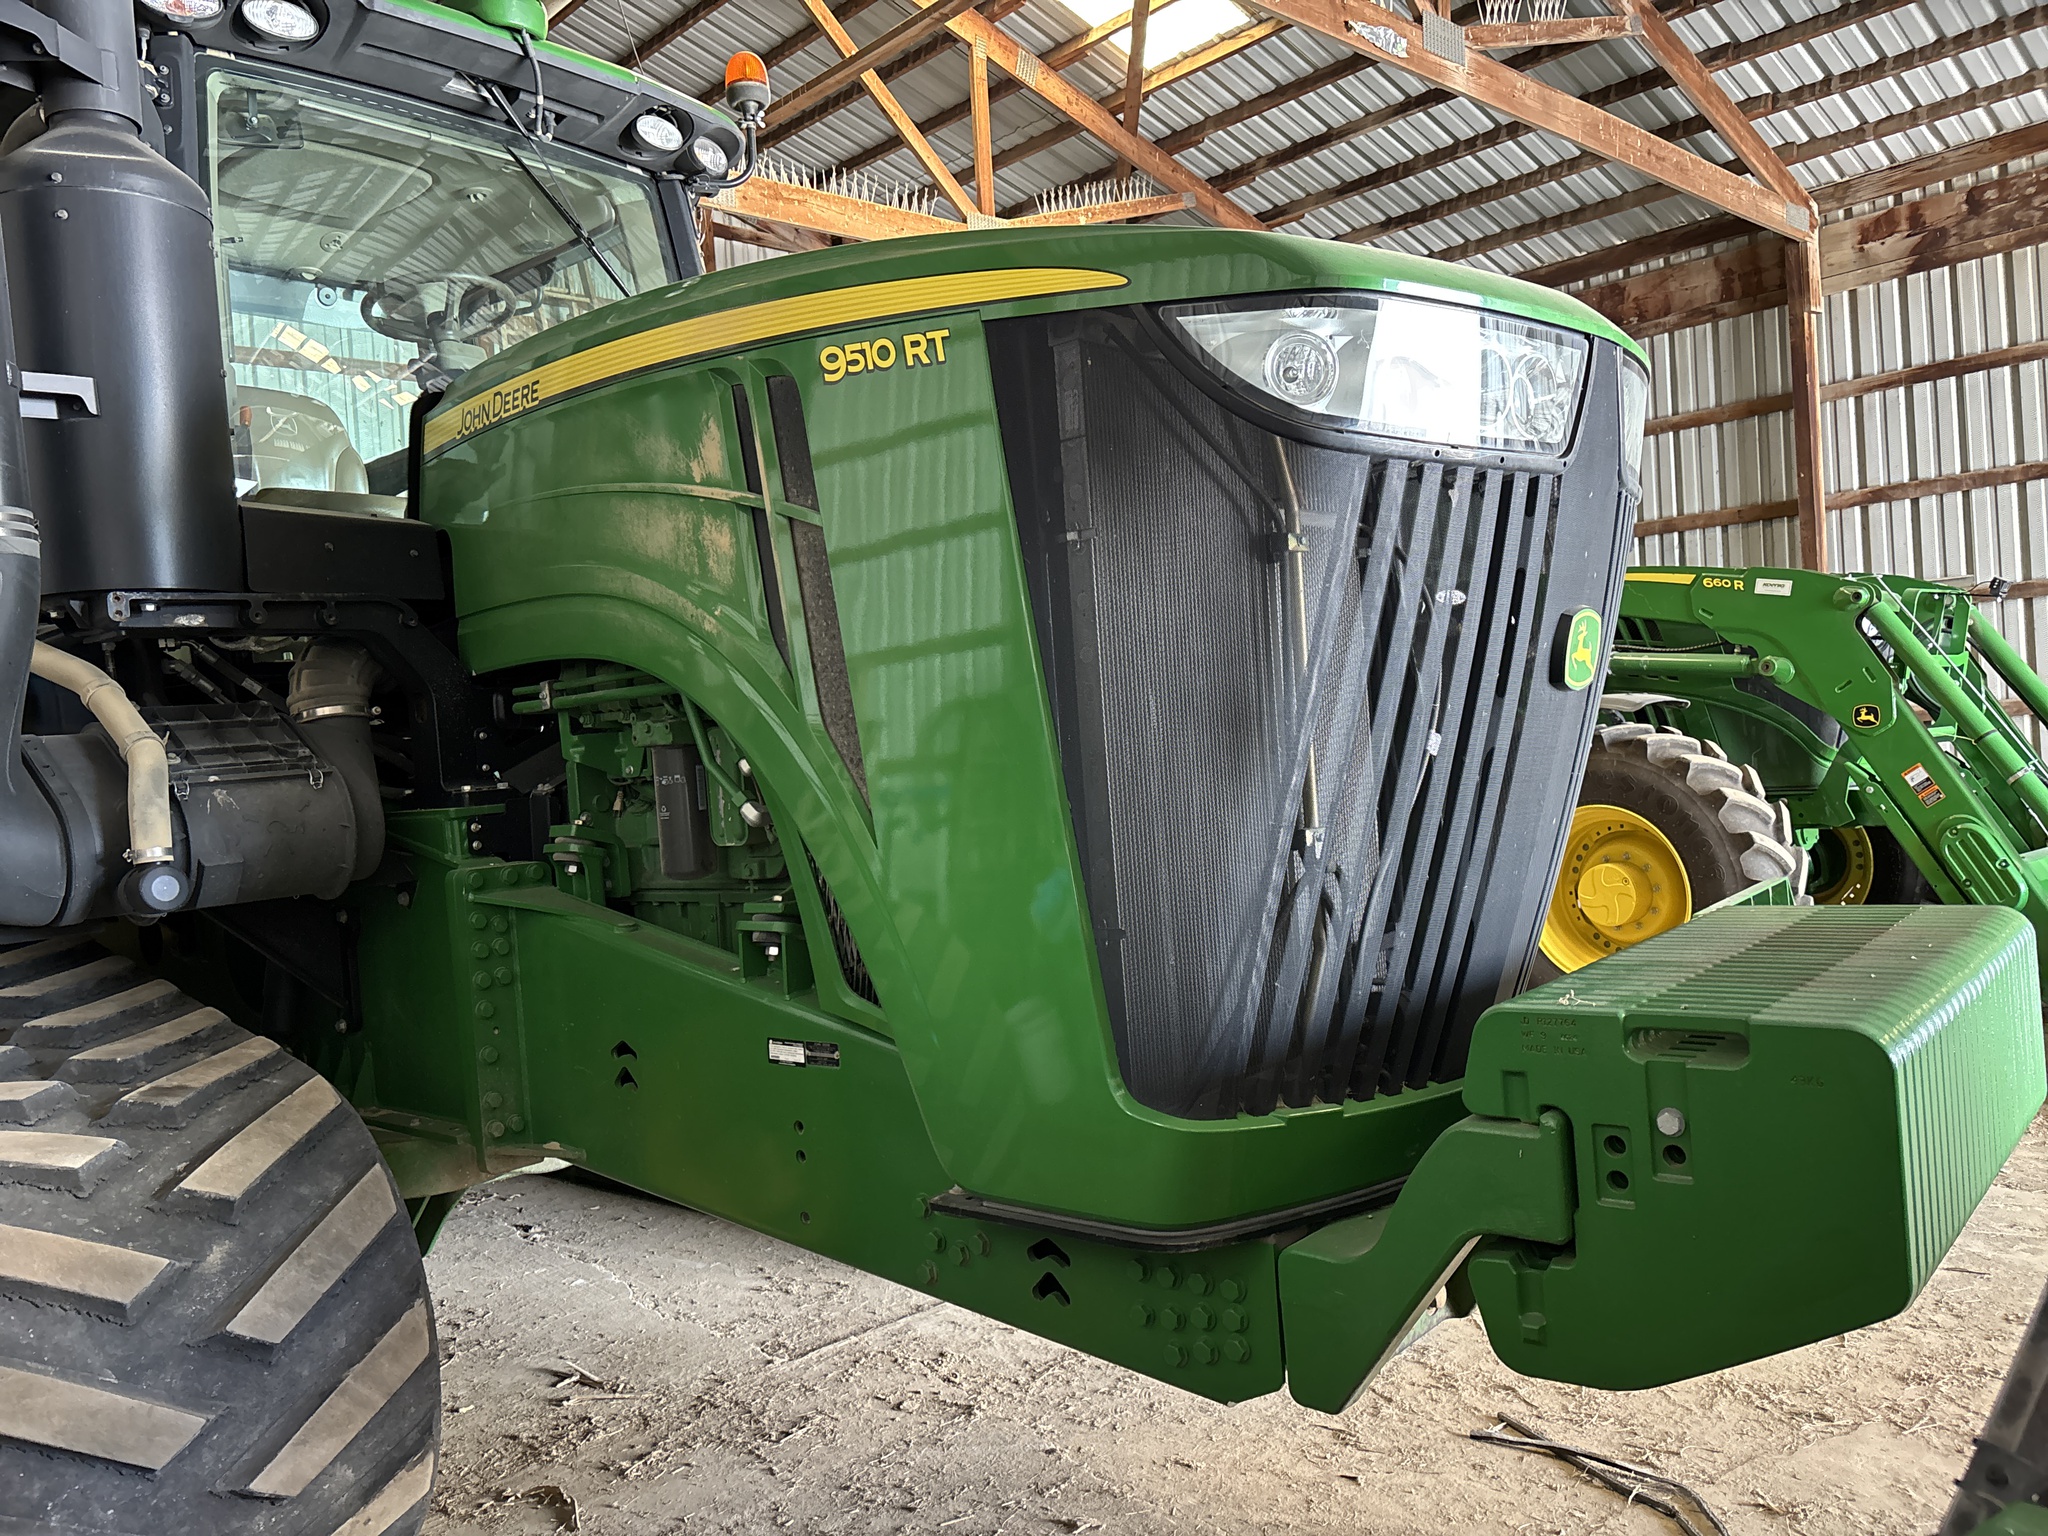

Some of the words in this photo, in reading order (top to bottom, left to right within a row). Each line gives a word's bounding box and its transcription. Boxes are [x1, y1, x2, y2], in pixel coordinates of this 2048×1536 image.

[819, 337, 897, 384] 9510
[902, 328, 950, 369] RT
[456, 400, 491, 438] JOHN
[492, 379, 540, 421] DEERE
[1702, 577, 1732, 589] 660
[1733, 579, 1745, 591] R
[1521, 1044, 1548, 1054] MADE
[1553, 1045, 1564, 1055] IN
[1568, 1046, 1586, 1056] USA
